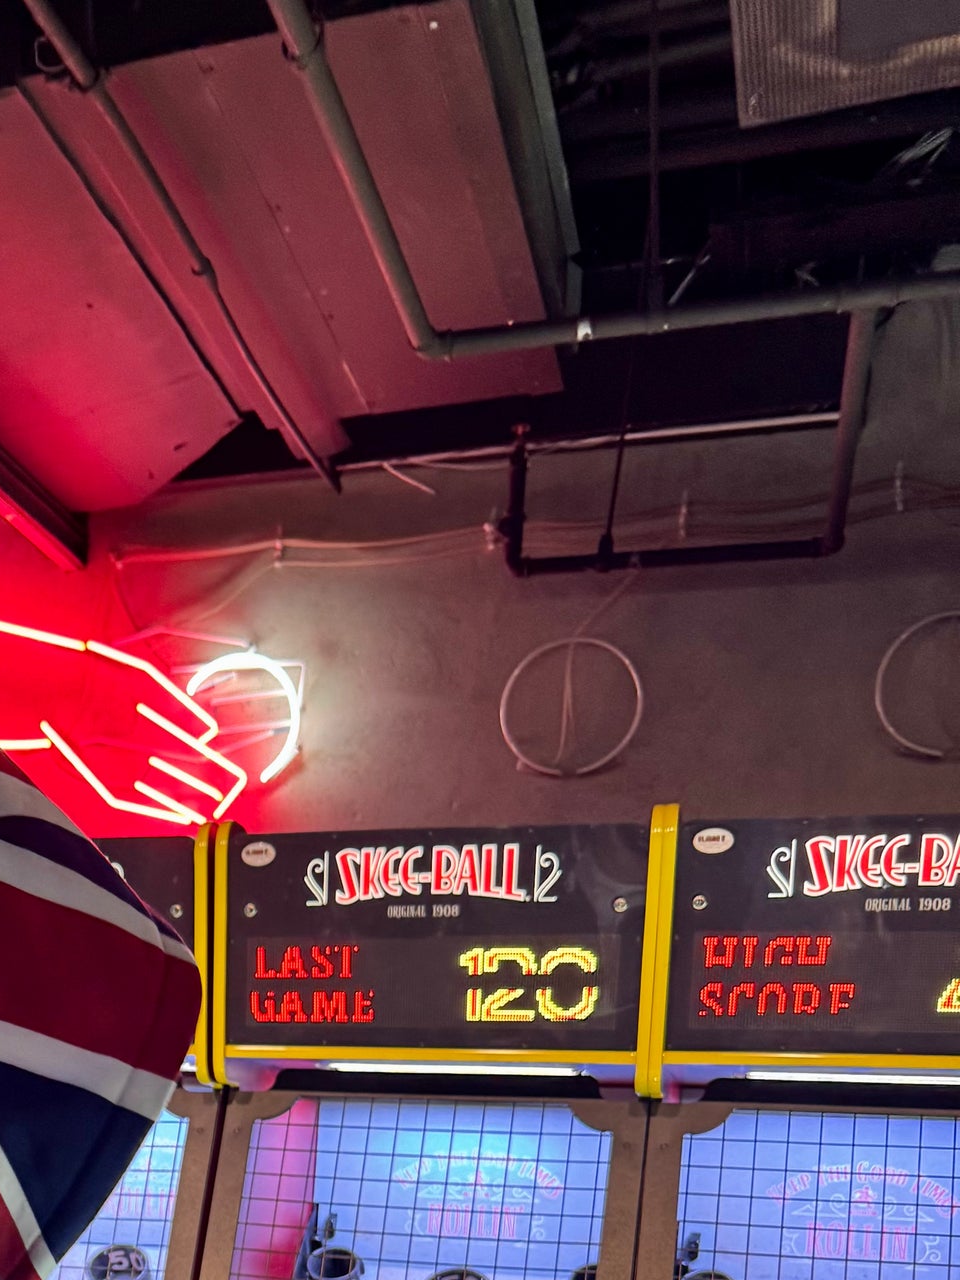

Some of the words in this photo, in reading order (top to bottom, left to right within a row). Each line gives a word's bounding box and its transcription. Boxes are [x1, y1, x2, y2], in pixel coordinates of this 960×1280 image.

[335, 843, 528, 905] SKEE-BALL
[387, 904, 427, 919] ORIGINAL
[432, 904, 460, 918] 1908
[865, 898, 911, 912] ORIGINAL
[918, 897, 951, 911] 1908
[254, 945, 360, 979] LAST
[459, 947, 599, 1022] 120
[249, 990, 376, 1023] GAME
[108, 1250, 146, 1272] 50
